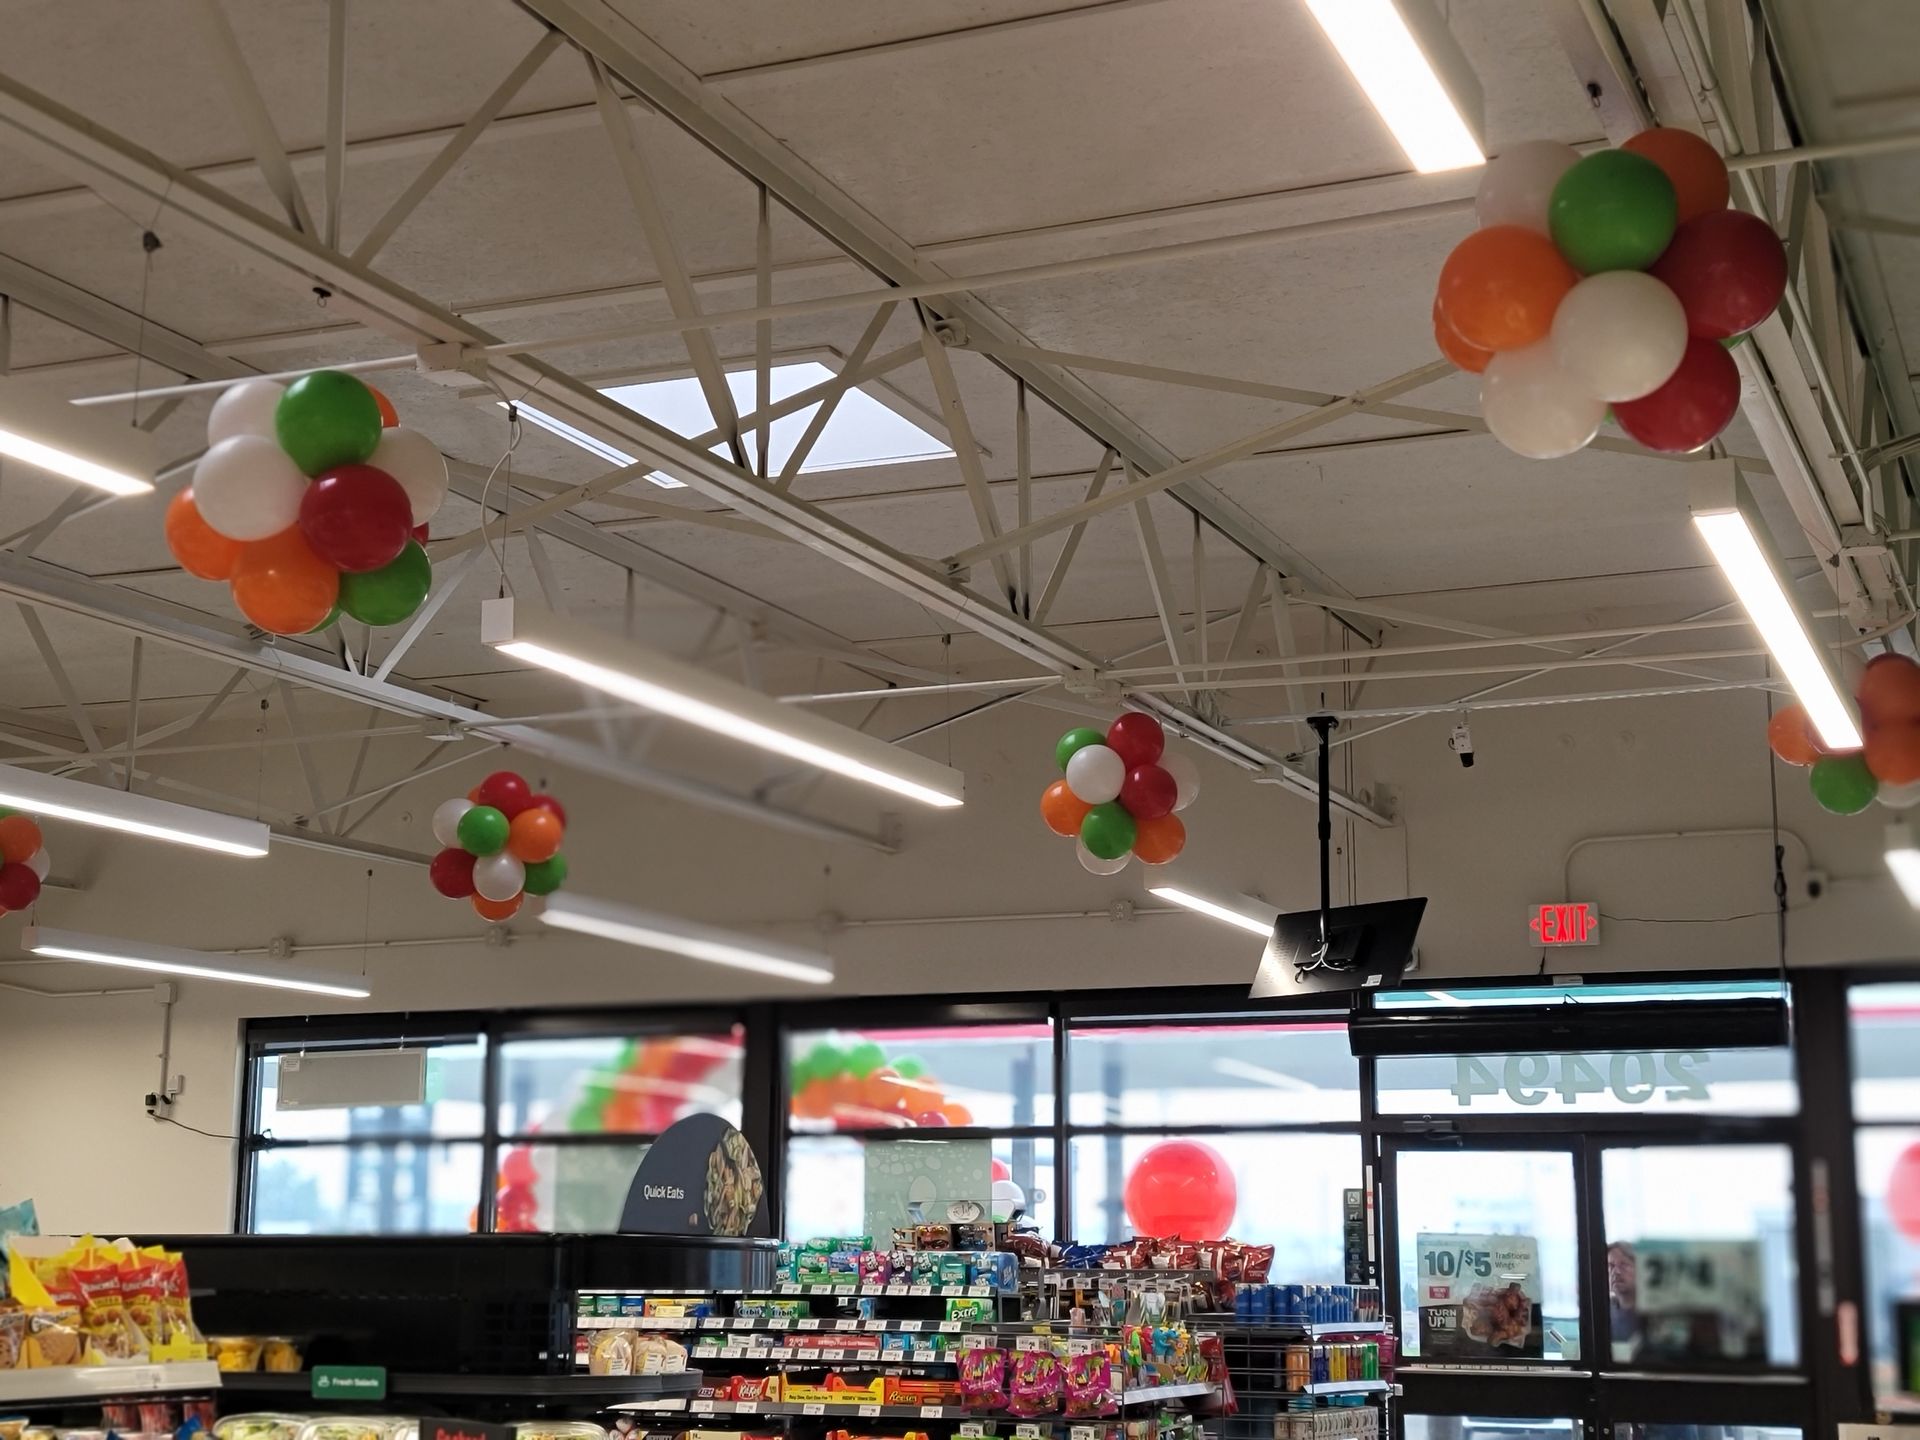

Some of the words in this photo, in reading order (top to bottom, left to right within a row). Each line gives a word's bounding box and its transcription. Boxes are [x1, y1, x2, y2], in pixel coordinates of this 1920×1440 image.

[1540, 905, 1589, 943] EXIT
[644, 1185, 666, 1200] Quick
[667, 1186, 684, 1199] Eats
[1424, 1250, 1492, 1278] 10/$5
[951, 1307, 978, 1321] Extra
[1429, 1316, 1445, 1327] UP
